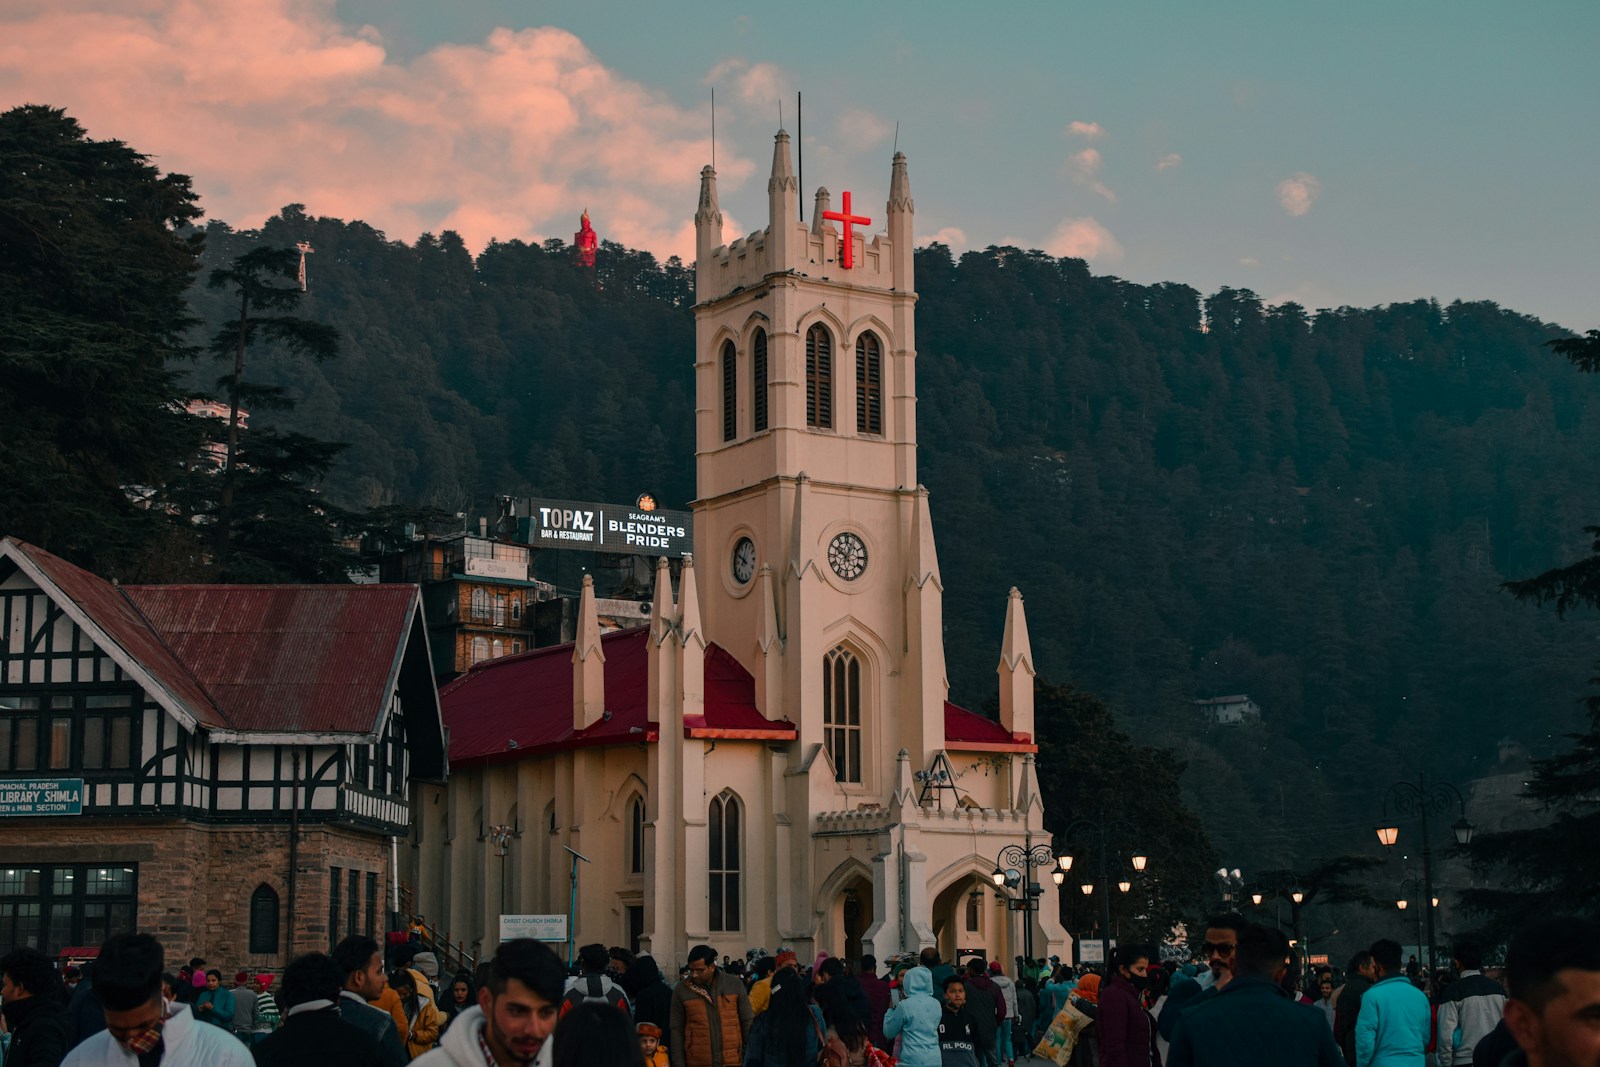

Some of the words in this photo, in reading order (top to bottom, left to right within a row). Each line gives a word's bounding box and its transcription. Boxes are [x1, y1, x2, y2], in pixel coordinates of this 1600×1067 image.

[539, 508, 594, 531] TOPAZ
[628, 513, 666, 523] SEAGRAM'S
[609, 520, 685, 538] BLENDERS
[541, 530, 553, 539] BAR
[559, 532, 594, 542] RESTAURANT
[626, 533, 670, 548] PRIDE
[29, 782, 59, 790] PRADESH
[0, 791, 40, 803] LIBRARY
[44, 790, 79, 802] SHIMLA
[954, 1042, 972, 1050] POLO
